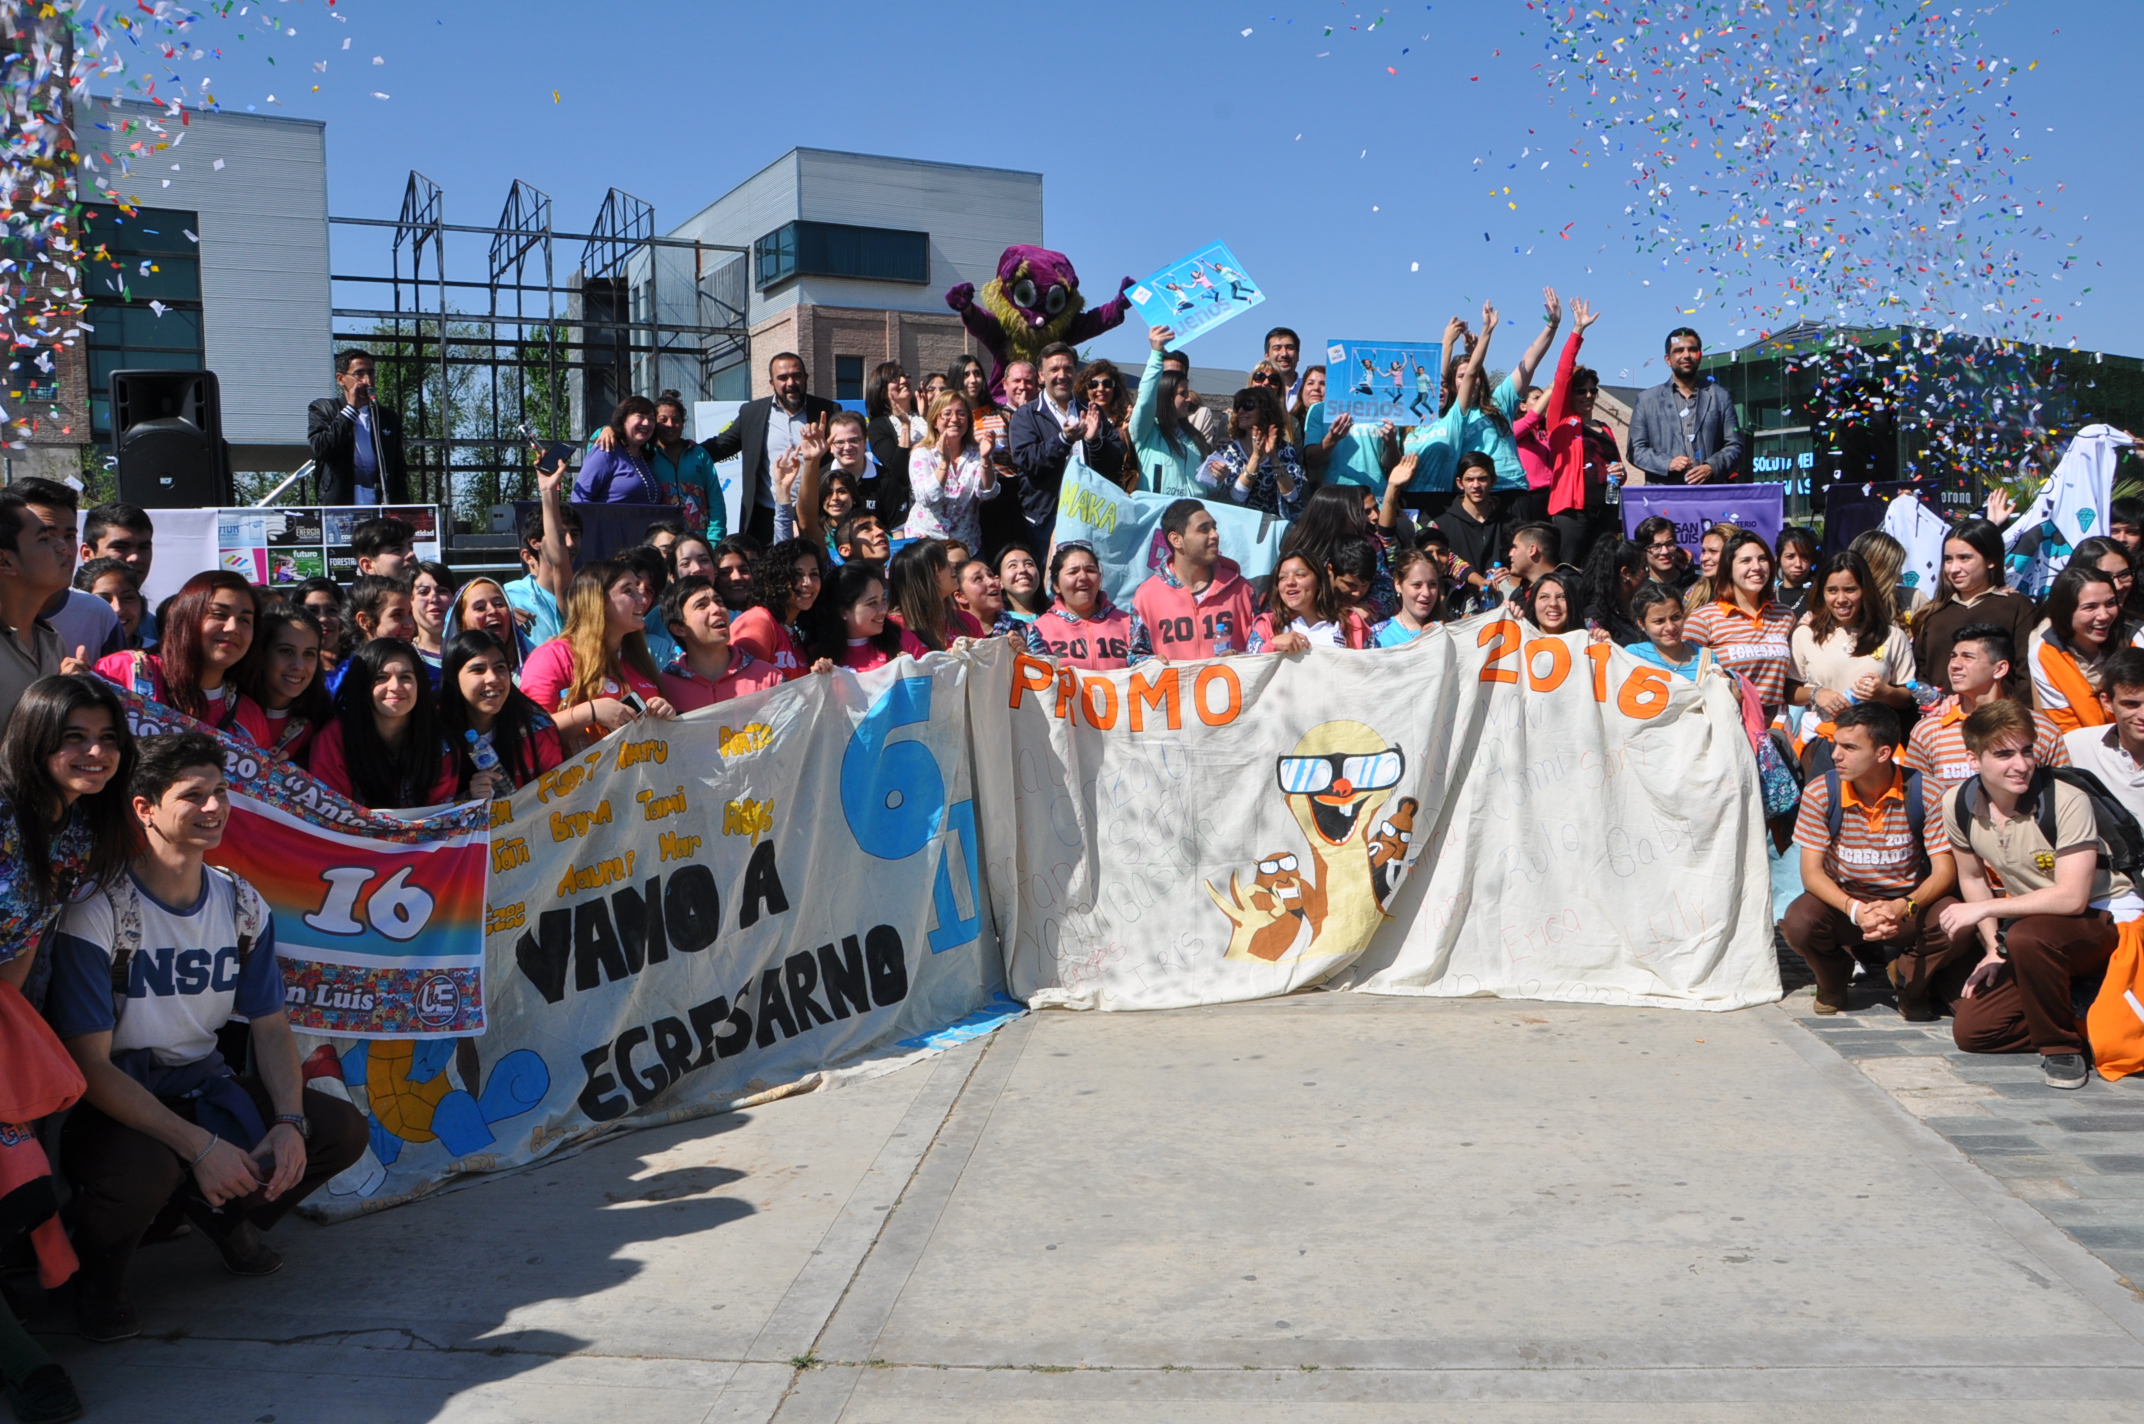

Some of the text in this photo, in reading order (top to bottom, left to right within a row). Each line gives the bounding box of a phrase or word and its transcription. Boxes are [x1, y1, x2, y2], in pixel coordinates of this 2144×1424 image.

[1171, 297, 1232, 337] ueños
[1057, 480, 1117, 534] MAKA
[1166, 487, 1185, 497] 2016
[1940, 491, 1972, 505] orona
[1674, 522, 1699, 533] SAN
[1676, 533, 1699, 544] LUIS
[293, 550, 318, 559] futuro
[1159, 611, 1234, 644] 2016
[774, 651, 797, 669] 16
[1050, 637, 1128, 659] 2016
[1009, 619, 1672, 732] PROMO 2016
[636, 785, 687, 821] Tami
[739, 838, 790, 930] A
[302, 865, 435, 942] 16
[1501, 906, 1584, 963] Erica
[313, 983, 375, 1011] Luis
[577, 924, 908, 1122] EGRESARNO
